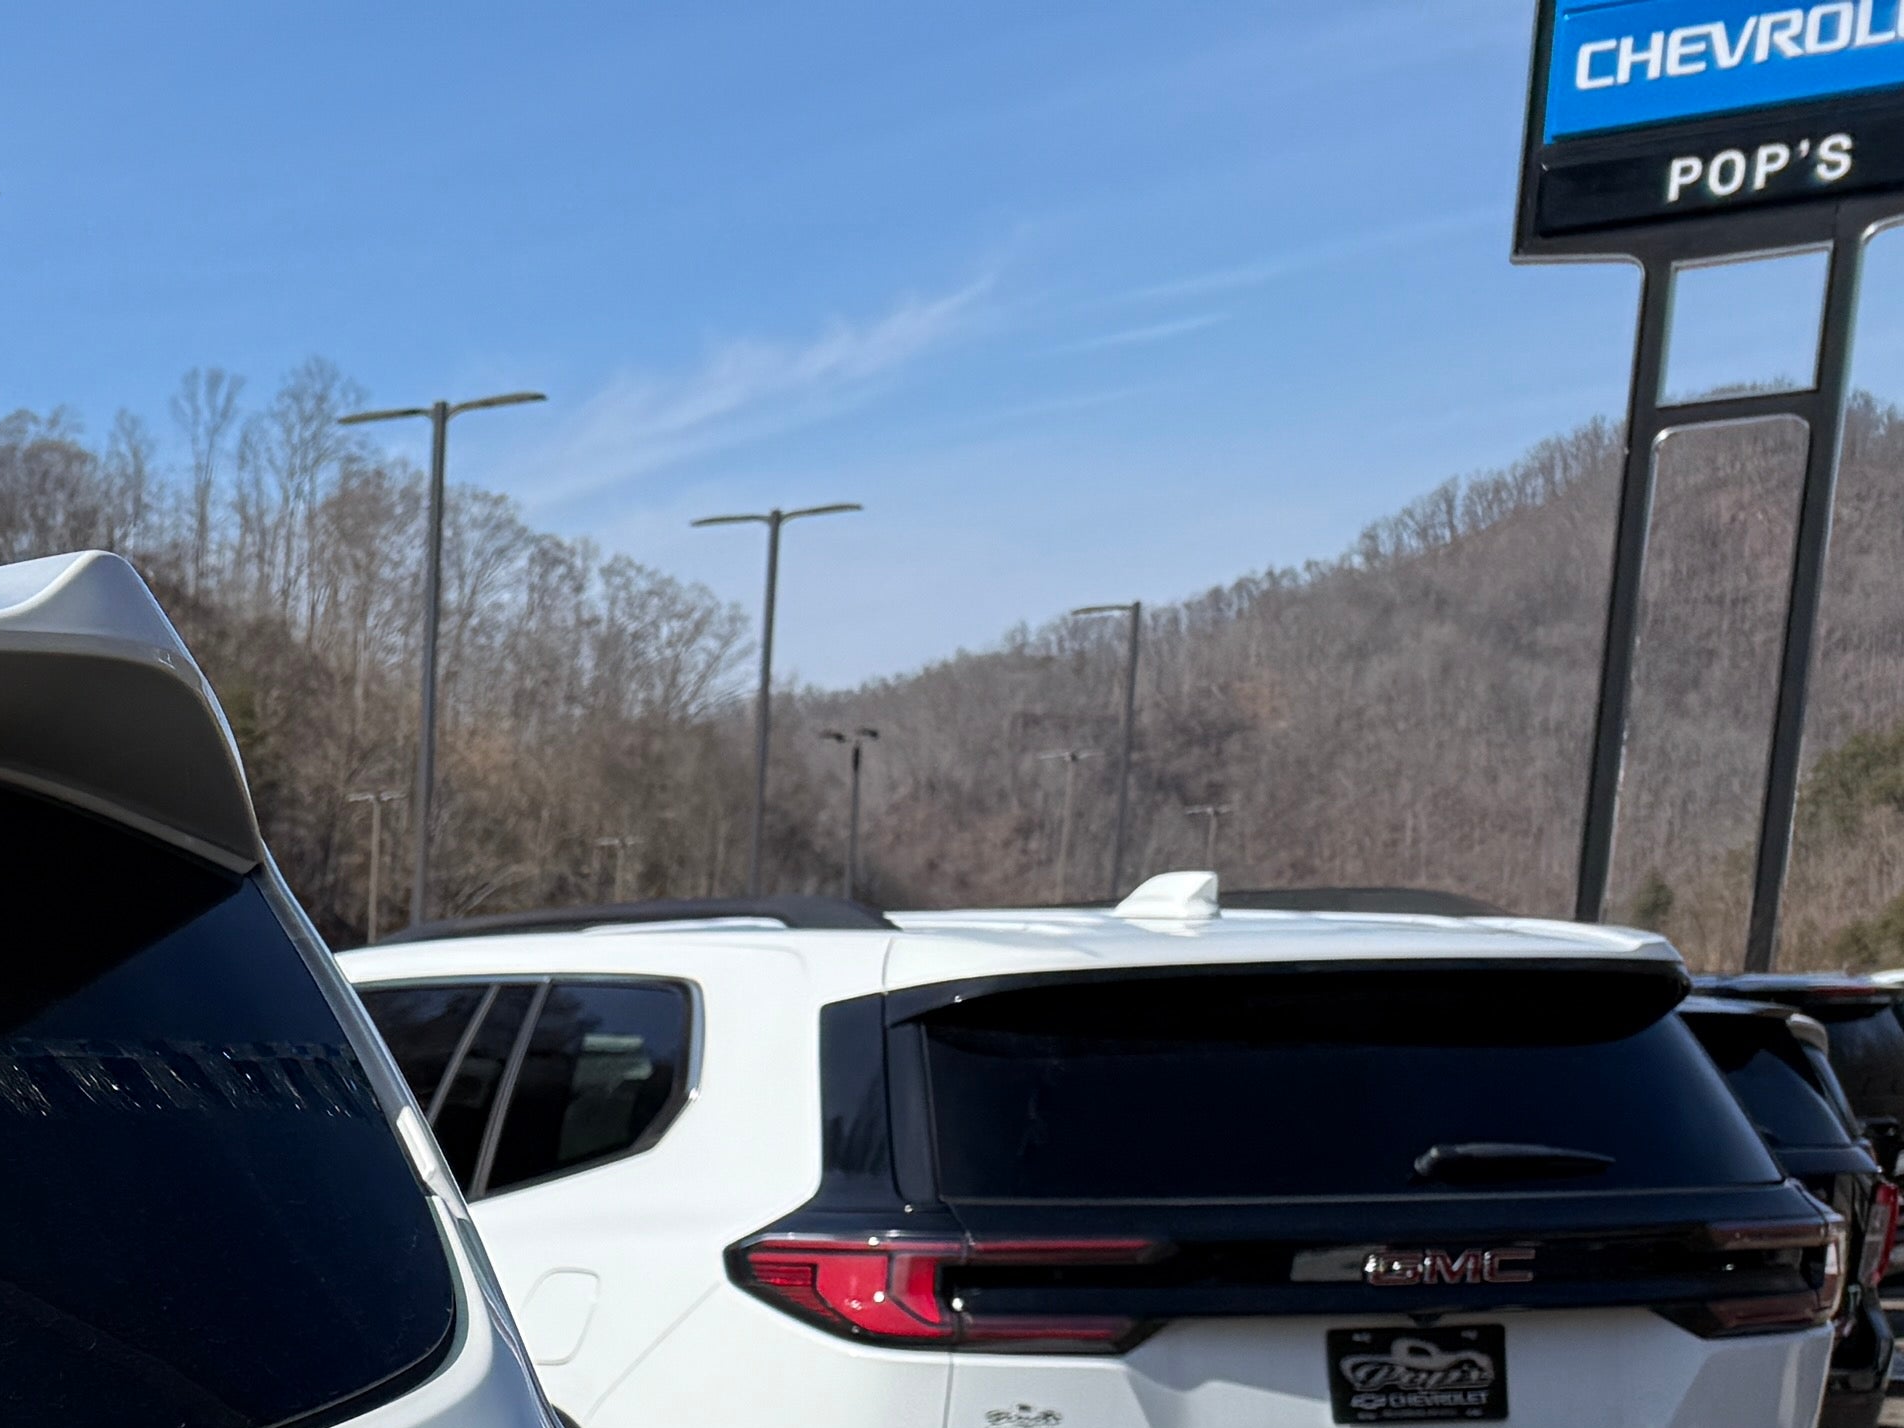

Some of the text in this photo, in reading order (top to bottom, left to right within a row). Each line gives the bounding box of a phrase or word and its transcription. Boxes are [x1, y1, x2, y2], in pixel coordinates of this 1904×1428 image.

[1575, 0, 1904, 90] CHEVROL
[1666, 132, 1854, 202] POP'S
[1364, 1248, 1536, 1286] GMC
